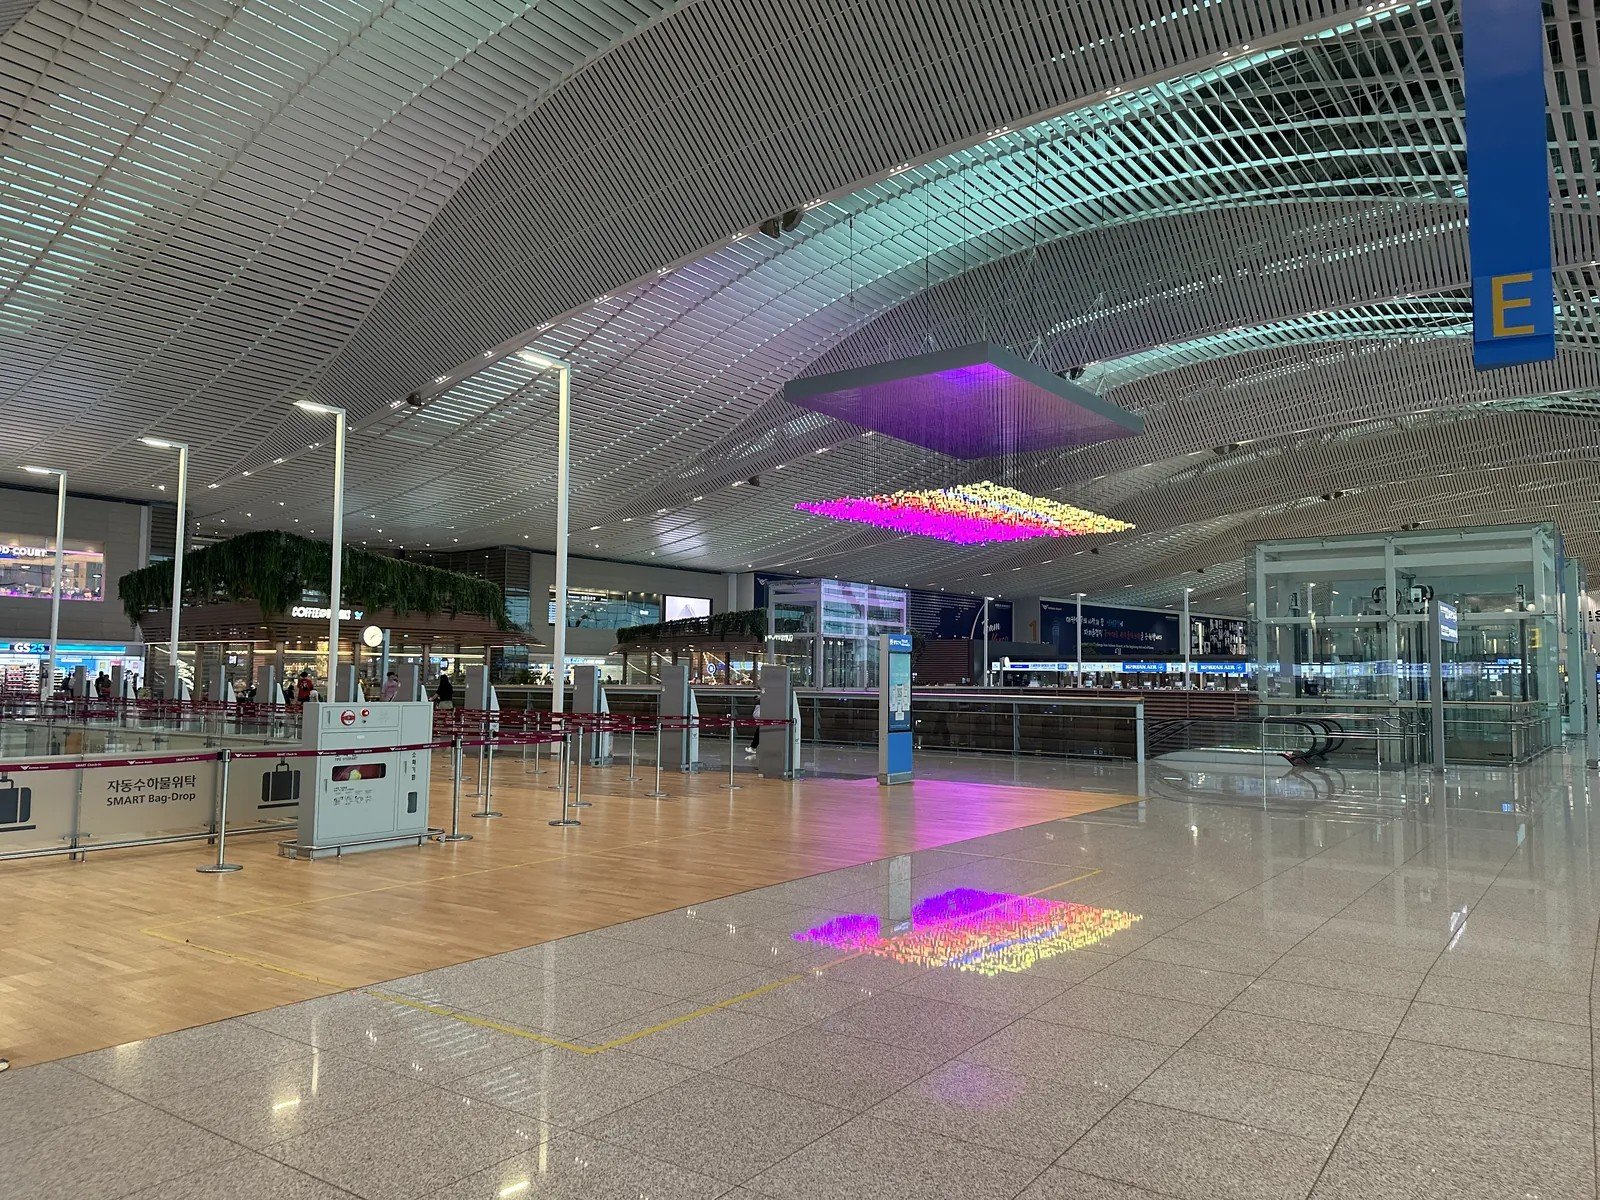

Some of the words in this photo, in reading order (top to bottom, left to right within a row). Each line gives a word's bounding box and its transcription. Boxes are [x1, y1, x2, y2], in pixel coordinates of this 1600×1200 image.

[1491, 272, 1535, 338] E
[13, 547, 48, 558] COURT
[14, 642, 46, 653] GS25
[107, 774, 196, 793] 자동수하물위탁
[106, 794, 146, 807] SMART
[148, 792, 196, 804] Bag-Drop
